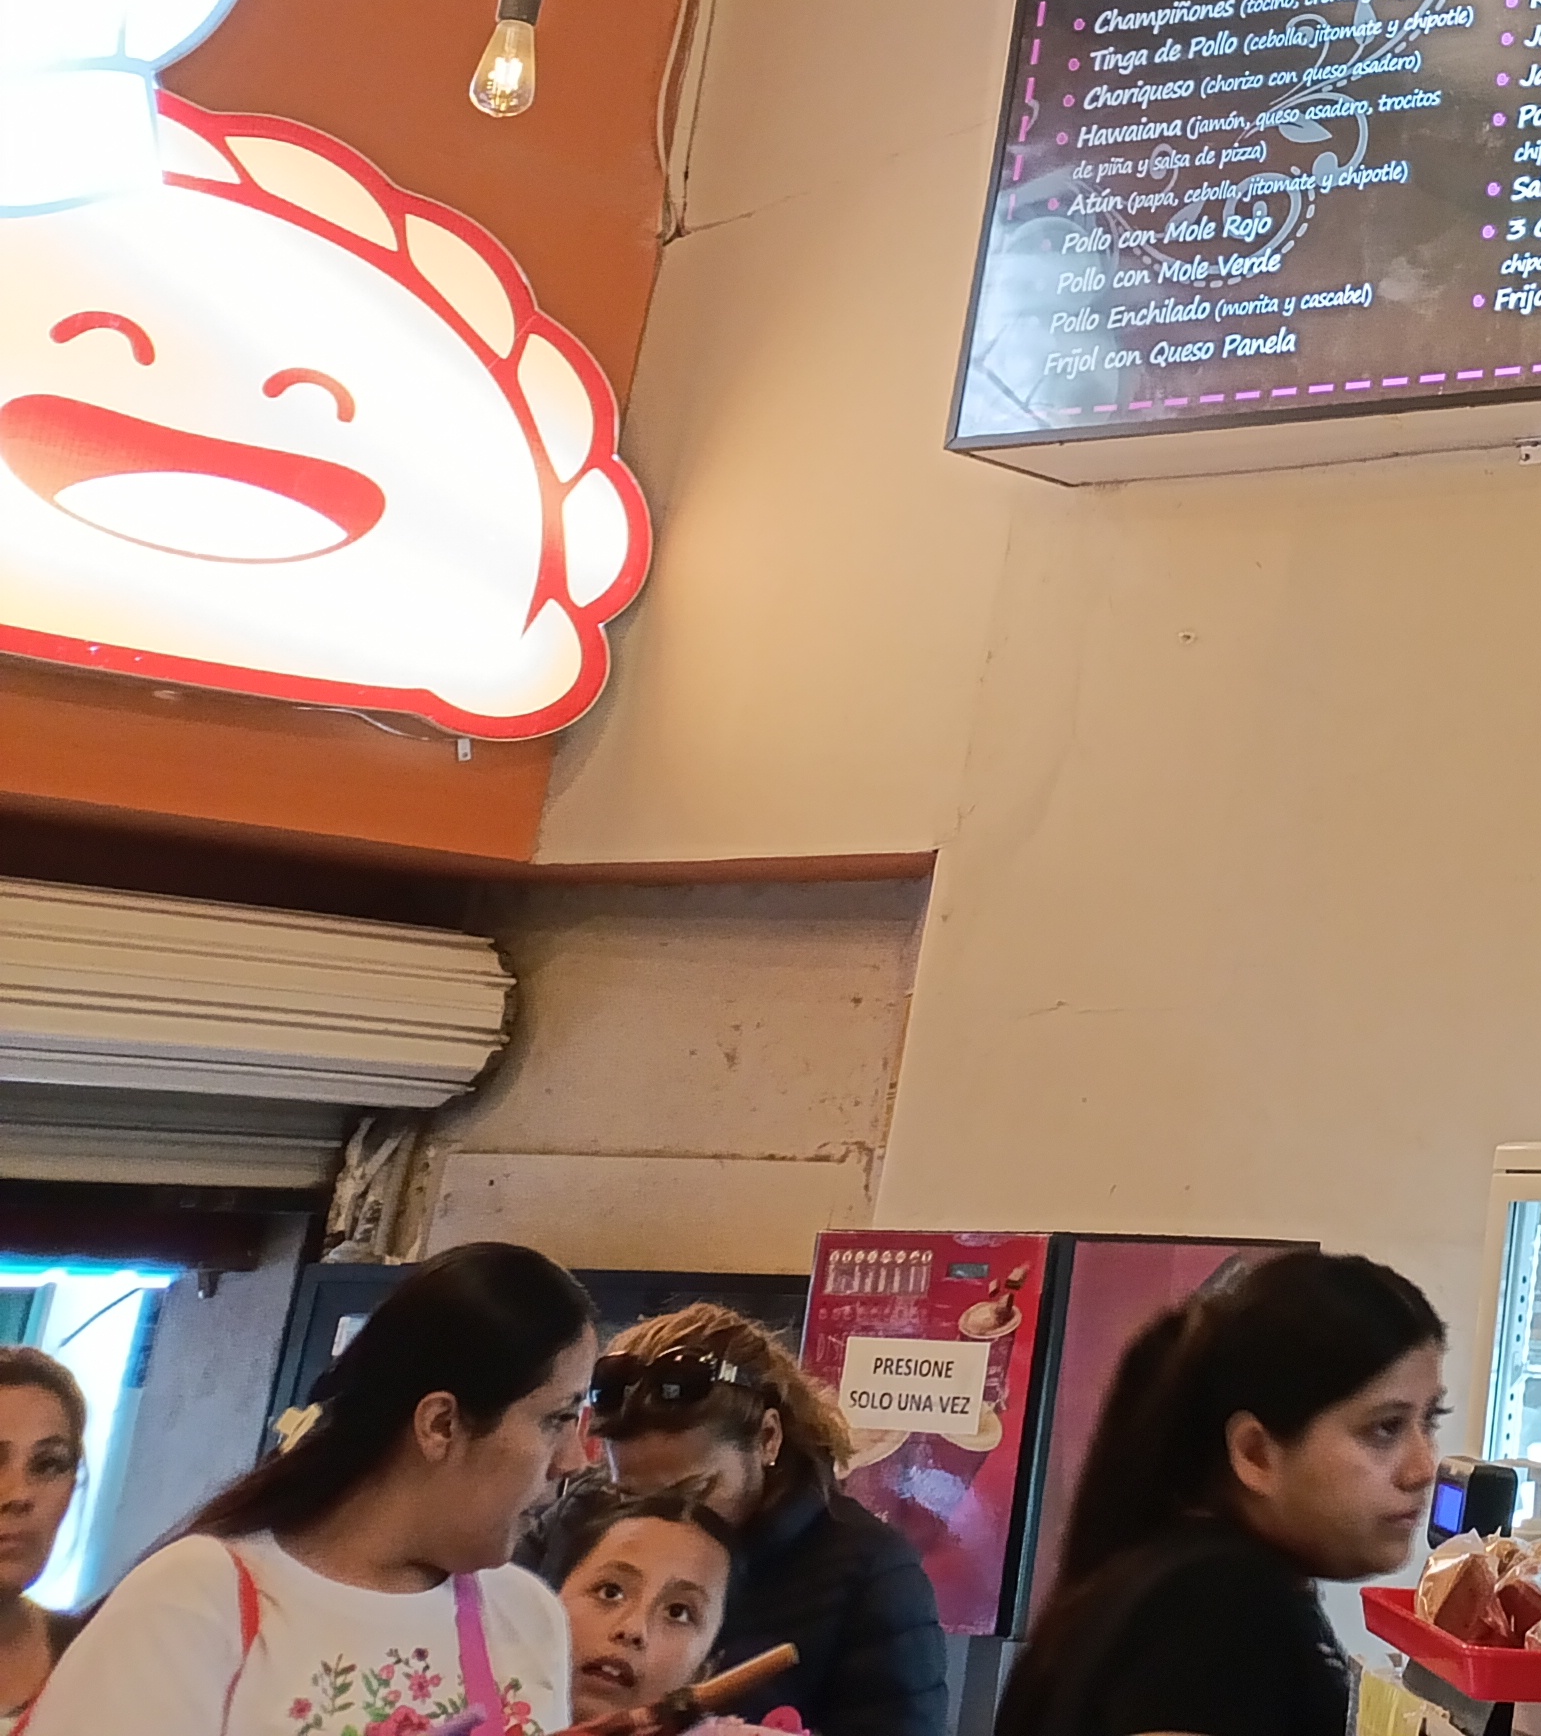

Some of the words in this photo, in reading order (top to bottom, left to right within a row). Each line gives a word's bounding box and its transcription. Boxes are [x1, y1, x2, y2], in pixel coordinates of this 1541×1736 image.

[1091, 49, 1148, 76] Tinga
[1154, 42, 1181, 62] de
[1188, 34, 1237, 58] Pollo
[1313, 19, 1381, 43] jitomate
[1387, 20, 1399, 37] y
[1403, 7, 1474, 32] chipotle)
[1063, 231, 1110, 256] Pollo
[1118, 229, 1156, 248] con
[1163, 218, 1215, 242] Mole
[1223, 213, 1273, 242] Rojo
[1044, 350, 1096, 378] Frijol
[1104, 349, 1142, 369] con
[1150, 340, 1213, 363] Queso
[1223, 329, 1296, 356] Panela
[873, 1357, 954, 1378] PRESIONE
[850, 1391, 892, 1410] SOLO
[897, 1393, 933, 1412] UNA
[940, 1396, 970, 1414] VEZ
